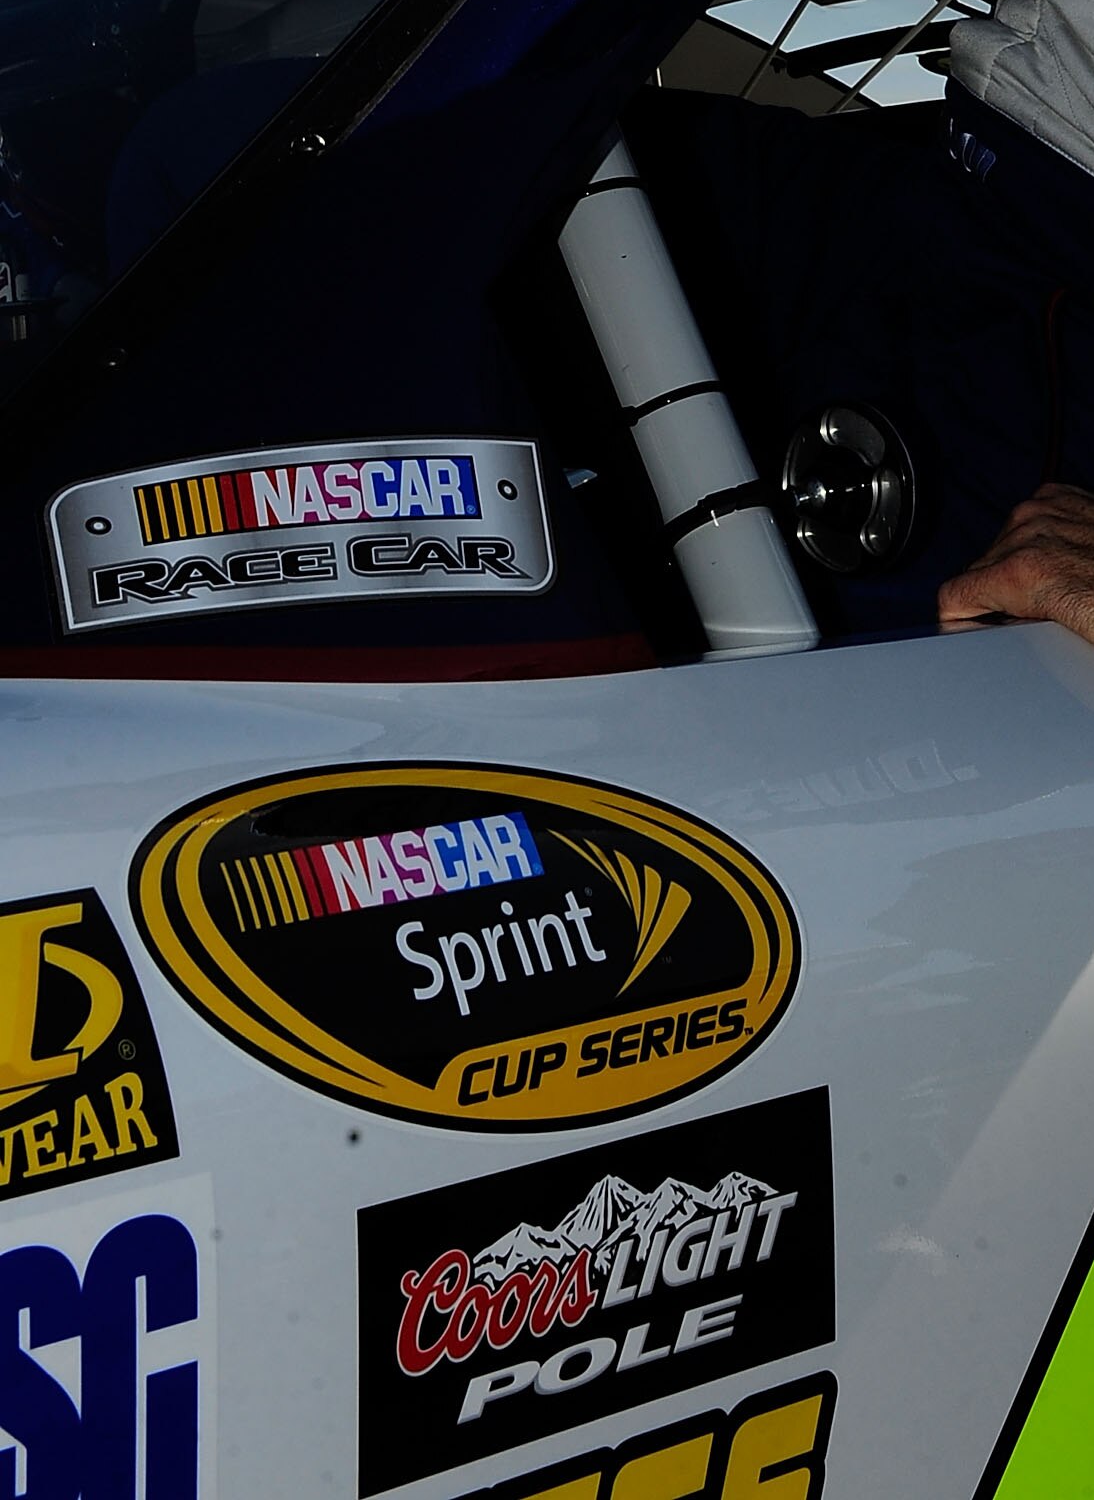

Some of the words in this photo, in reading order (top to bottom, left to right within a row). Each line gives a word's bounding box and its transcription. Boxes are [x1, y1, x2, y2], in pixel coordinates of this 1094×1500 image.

[250, 458, 466, 528] NASCAR
[91, 541, 338, 606] RACE
[346, 533, 533, 580] CAR
[321, 814, 532, 912] NASCAR
[395, 890, 607, 1017] Sprint
[456, 1041, 568, 1107] CUP
[576, 998, 749, 1079] SERIES
[396, 1248, 599, 1377] Coors
[601, 1191, 799, 1310] LIGHT
[456, 1294, 744, 1426] POLE
